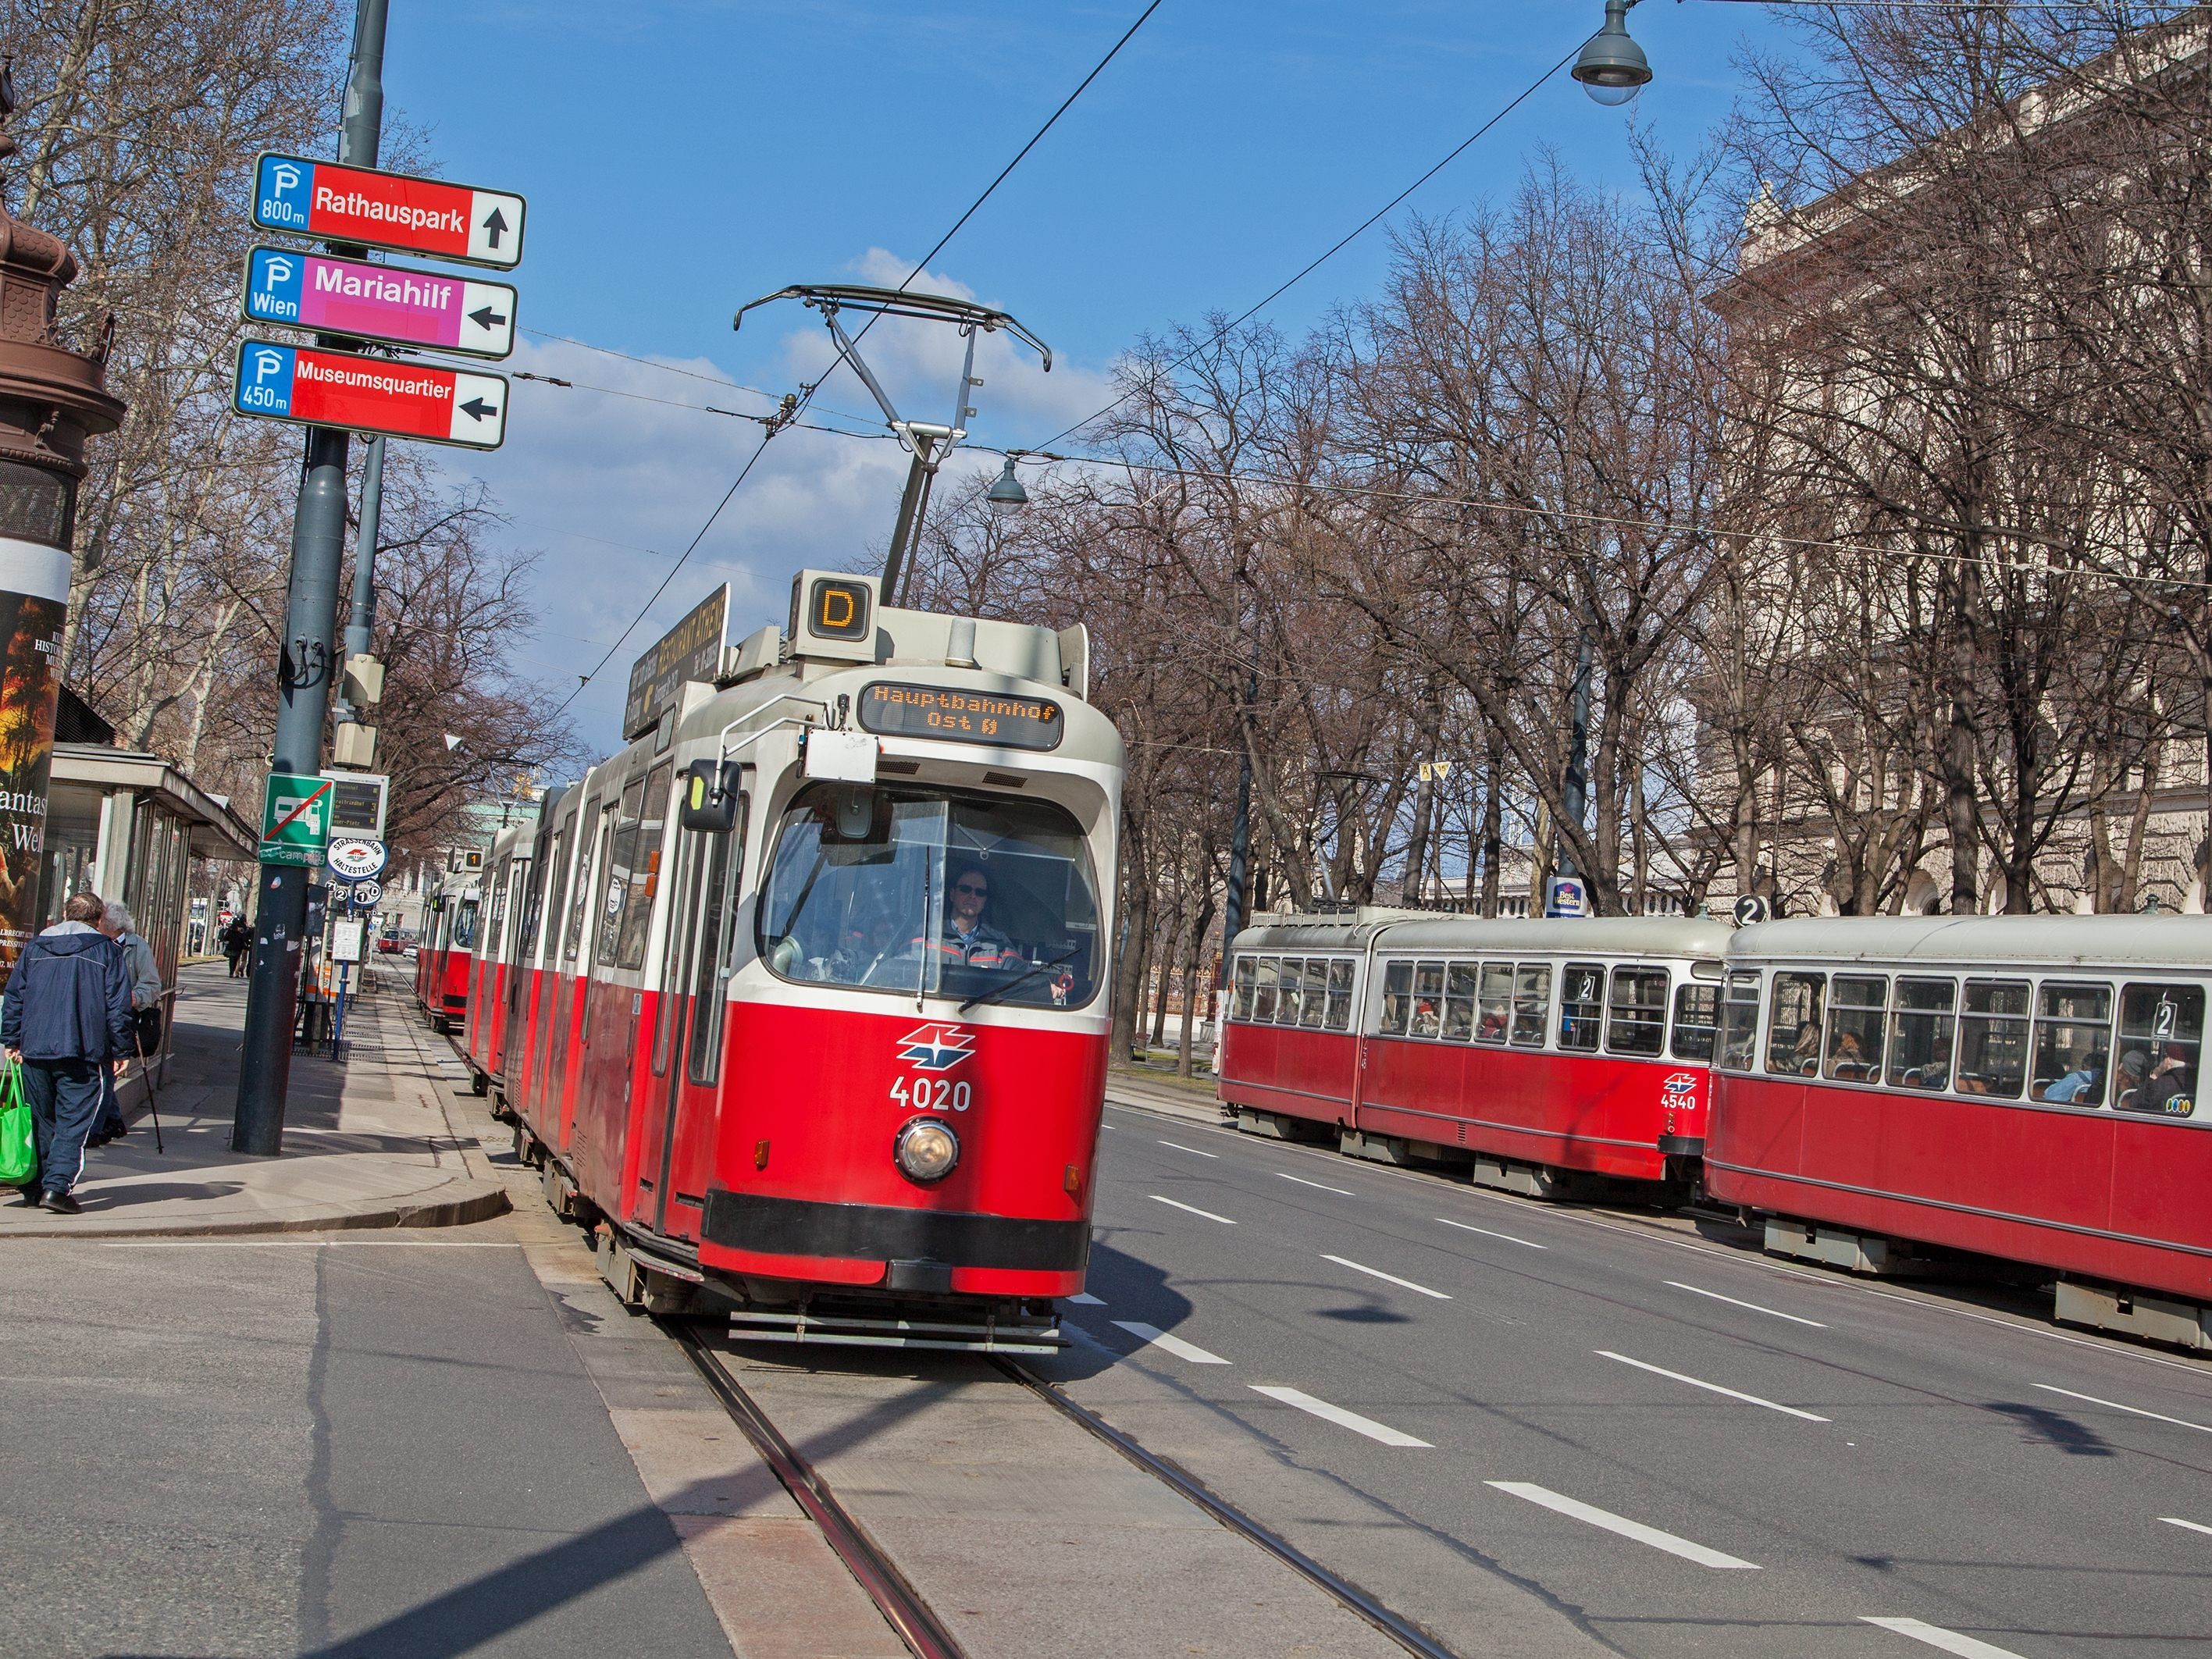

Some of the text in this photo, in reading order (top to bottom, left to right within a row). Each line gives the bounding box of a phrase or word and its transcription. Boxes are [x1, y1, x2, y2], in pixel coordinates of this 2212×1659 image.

[274, 171, 298, 198] P
[315, 187, 465, 233] Rathauspark
[266, 263, 290, 291] P
[315, 265, 451, 310] Mariahilf
[253, 291, 297, 317] Wien
[257, 357, 280, 384] P
[297, 361, 451, 400] Museumsquartier
[823, 589, 853, 627] D
[874, 686, 1055, 720] Hauptbahnhof
[927, 712, 971, 731] Ost
[1423, 766, 1429, 775] A
[333, 838, 383, 856] STRASSENBAHN
[333, 857, 378, 874] HALTESTELLE
[471, 854, 476, 864] 1
[337, 890, 345, 899] 2
[359, 892, 365, 902] 1
[371, 887, 379, 897] D
[1555, 896, 1580, 906] Western
[1560, 891, 1575, 899] Best
[1742, 899, 1758, 925] 2
[1580, 977, 1591, 998] 2
[2157, 1006, 2172, 1034] 2
[889, 1076, 971, 1112] 4020
[1661, 1094, 1696, 1110] 4540
